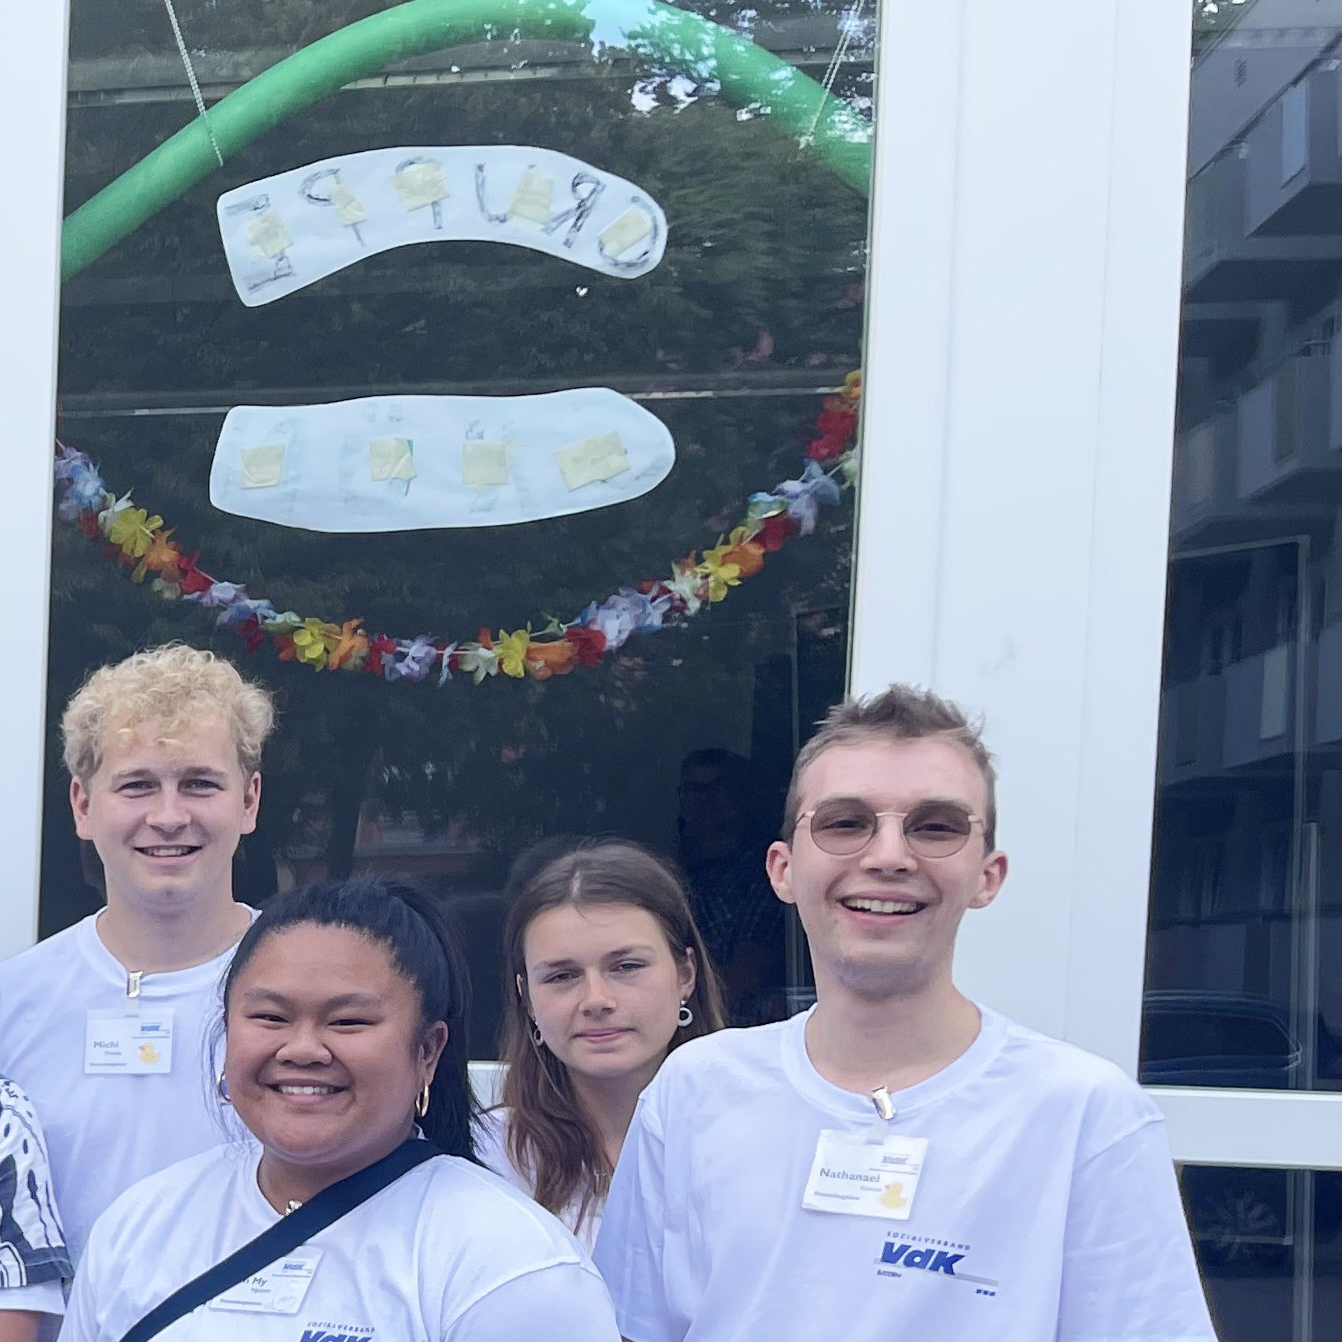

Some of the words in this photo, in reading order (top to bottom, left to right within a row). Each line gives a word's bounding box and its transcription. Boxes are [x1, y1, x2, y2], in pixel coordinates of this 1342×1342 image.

[819, 1168, 881, 1183] Nathanael
[887, 1230, 971, 1251] SOZIALVERBAND
[880, 1241, 966, 1275] VdK
[307, 1321, 376, 1334] SOZIALVERBAND
